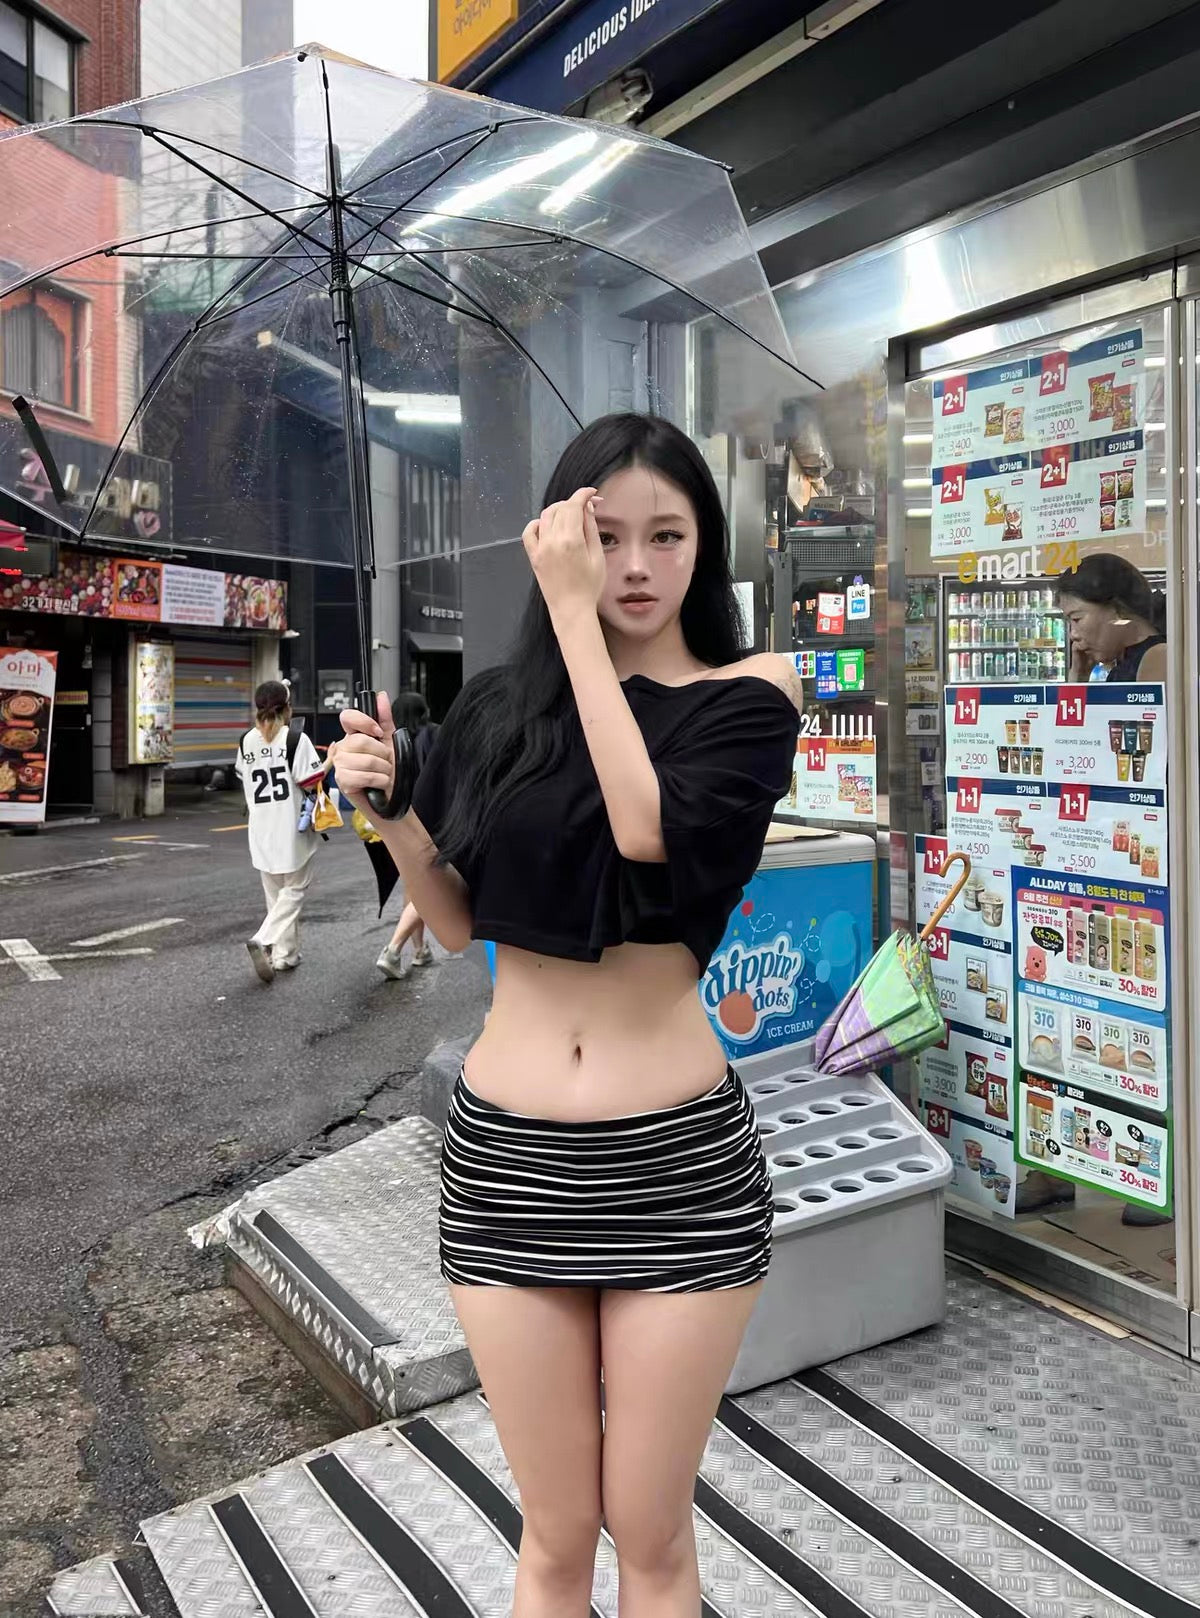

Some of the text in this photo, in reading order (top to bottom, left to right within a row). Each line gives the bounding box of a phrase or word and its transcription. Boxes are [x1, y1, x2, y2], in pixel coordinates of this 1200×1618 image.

[563, 6, 628, 78] DELICIOUS
[1107, 339, 1134, 354] 인기상품
[1000, 369, 1023, 382] 인기상품
[1042, 364, 1065, 390] 2+1
[944, 386, 964, 411] 2+1
[1049, 417, 1075, 434] 3,000
[1108, 439, 1135, 453] 인기상품
[999, 460, 1023, 472] 인기상품
[1043, 457, 1066, 482] 2+1
[943, 475, 963, 498] 2+1
[1051, 516, 1077, 531] 3,400
[949, 526, 971, 539] 3,000
[851, 589, 866, 598] LINE
[852, 602, 865, 611] Pay
[1013, 694, 1037, 703] 인기상품
[1127, 693, 1155, 703] 인기상품
[957, 699, 976, 719] 1+1
[1060, 698, 1082, 720] 1+1
[800, 714, 822, 737] 24
[809, 748, 825, 767] 1+1
[965, 752, 988, 765] 2,900
[1068, 755, 1096, 770] 3,200
[251, 765, 290, 805] 25
[1016, 785, 1041, 795] 인기상품
[959, 787, 978, 808] 1+1
[1063, 793, 1085, 816] 1+1
[1129, 793, 1156, 804] 인기상품
[967, 842, 990, 855] 4,500
[1070, 853, 1096, 868] 5,500
[1029, 876, 1067, 892] ALLDAY
[928, 932, 947, 955] 3+1
[982, 937, 1005, 950] 인기상품
[1118, 978, 1157, 998] 30% 할인
[753, 986, 791, 1012] dots
[1034, 1010, 1055, 1029] 310
[1075, 1018, 1092, 1031] 310
[766, 1019, 814, 1039] ICE CREAM
[1103, 1026, 1120, 1039] 310
[1132, 1032, 1150, 1045] 310
[933, 1076, 957, 1094] 3,900
[1119, 1075, 1159, 1098] 30% 할인
[929, 1109, 949, 1132] 3+1
[1119, 1169, 1158, 1193] 30% 할인
